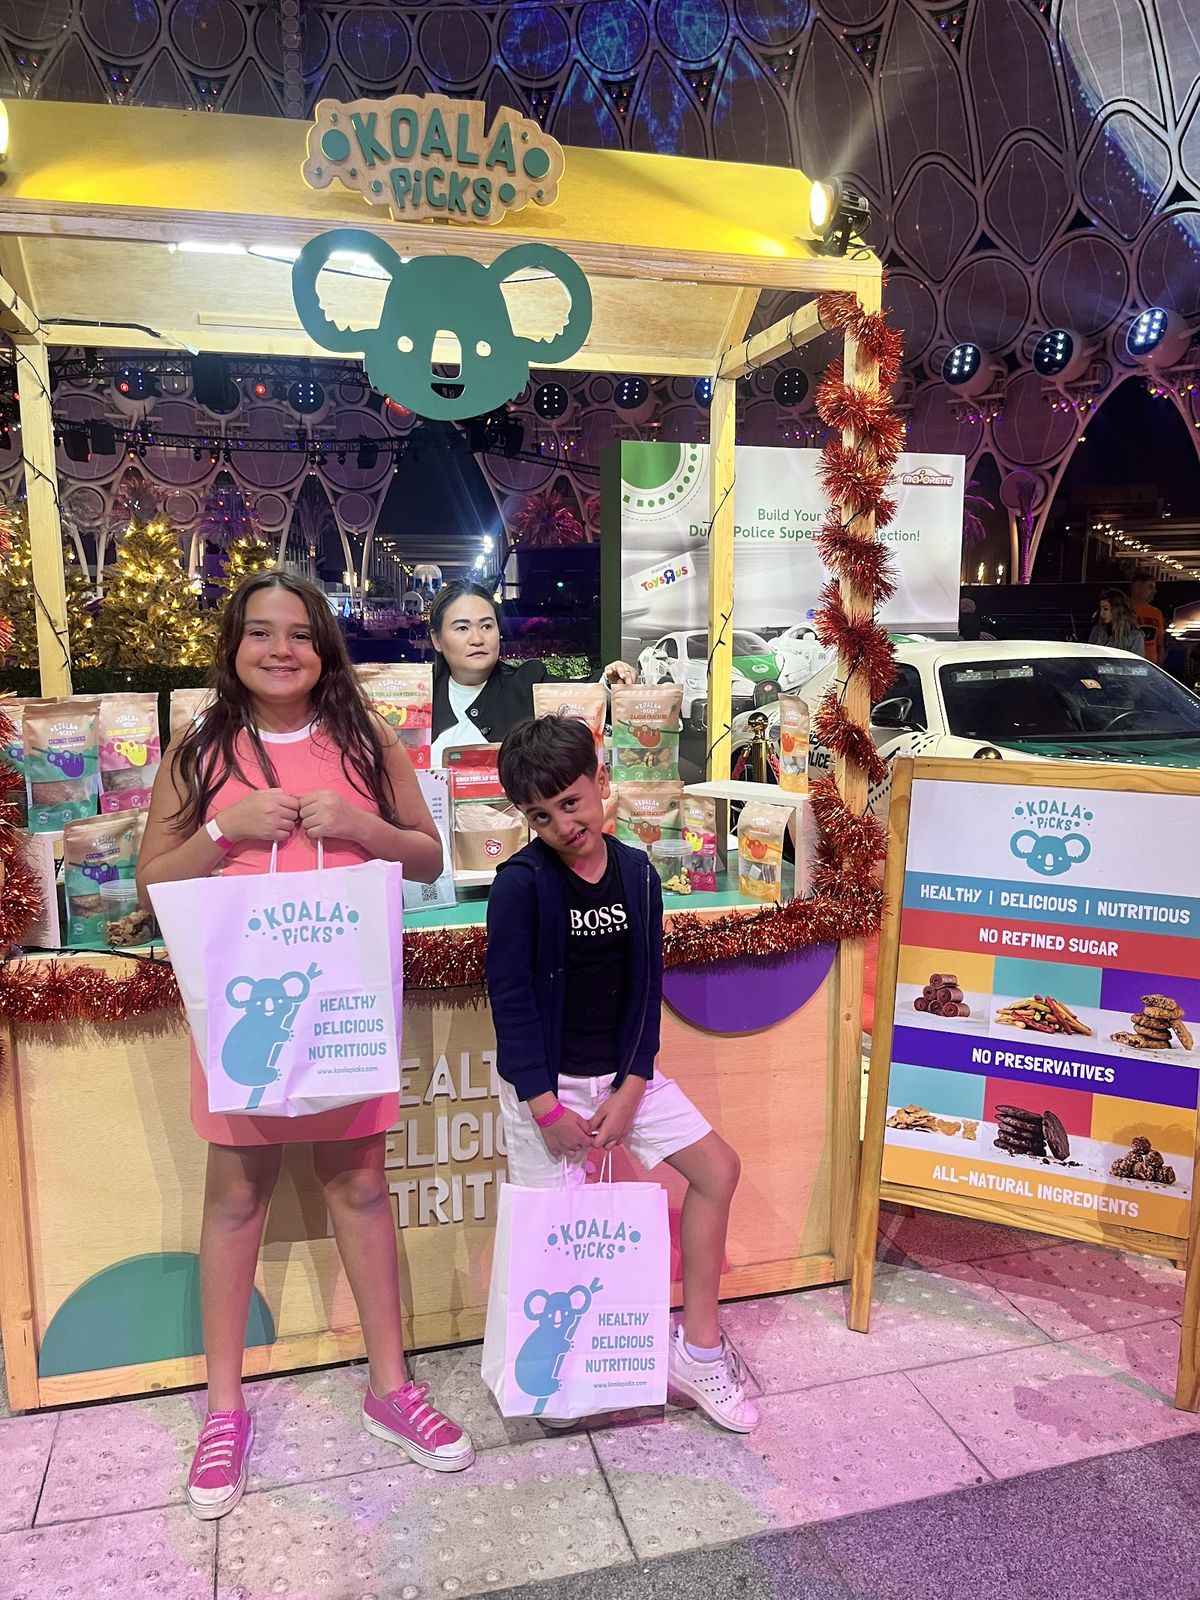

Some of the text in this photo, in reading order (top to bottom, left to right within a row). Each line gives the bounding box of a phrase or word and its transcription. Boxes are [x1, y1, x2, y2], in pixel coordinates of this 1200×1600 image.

[350, 108, 516, 173] KOALA
[758, 508, 821, 522] Build Your
[733, 526, 775, 538] Police
[779, 526, 820, 542] Super
[808, 751, 831, 769] LICE
[1026, 800, 1082, 819] KOALA
[920, 884, 1191, 924] HEALTHY DELICIOUS NUTRITIOUS
[263, 901, 344, 930] KOALA
[570, 904, 627, 929] BOSS
[600, 923, 628, 934] BOSS
[979, 927, 1119, 957] NO REFINED SUGAR
[320, 995, 377, 1013] HEALTHY
[314, 1018, 384, 1036] DELICIOUS
[308, 1042, 387, 1061] NUTRITIOUS
[317, 1065, 378, 1075] www.koalapicks.com
[972, 1048, 1115, 1083] NO PRESERVATIVES
[399, 1051, 501, 1107] EALT
[932, 1165, 1139, 1218] ALL-NATURAL INGREDIENTS
[560, 1218, 626, 1245] KOALA
[598, 1312, 650, 1327] HEALTHY
[592, 1335, 654, 1350] DELICIOUS
[585, 1357, 656, 1373] NUTRITIOUS
[593, 1379, 648, 1389] www.koalapicks.com
